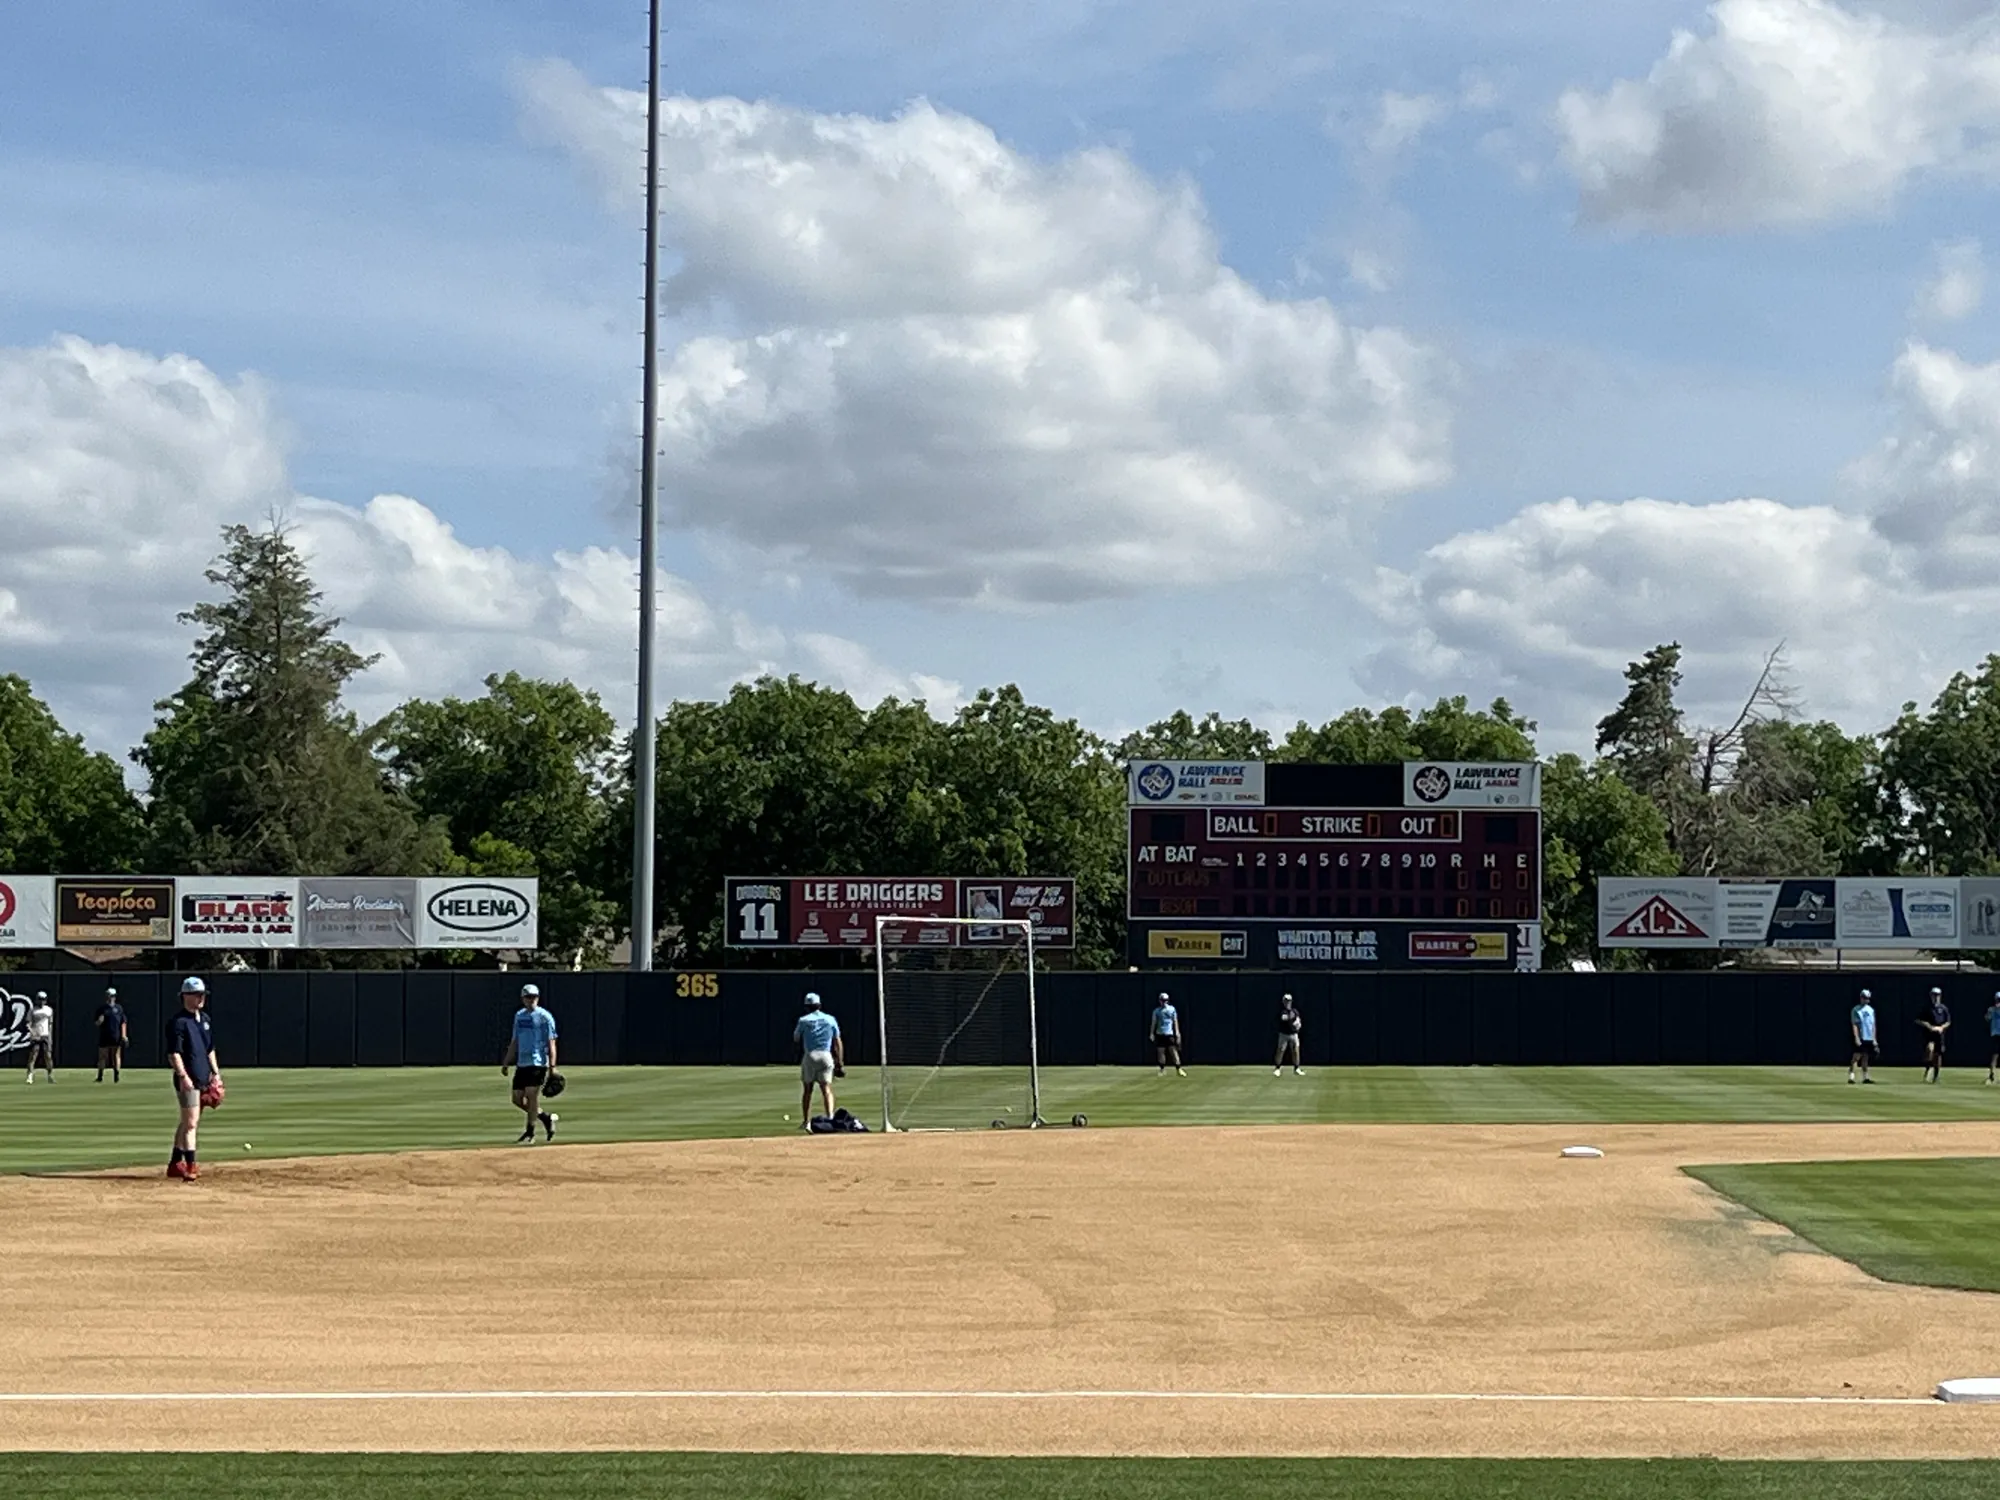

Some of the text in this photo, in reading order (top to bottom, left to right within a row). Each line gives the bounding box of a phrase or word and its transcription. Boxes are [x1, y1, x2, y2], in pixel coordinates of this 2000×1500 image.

[1180, 766, 1246, 777] LAWRENCE
[1456, 768, 1522, 778] LAWRENCE
[1454, 779, 1482, 790] HALL
[1214, 816, 1259, 833] BALL
[1302, 817, 1363, 834] STRIKE
[1400, 817, 1436, 834] OUT
[1138, 845, 1197, 862] AT BAT
[1236, 853, 1244, 867] 1
[1256, 853, 1266, 867] 2
[1277, 853, 1287, 867] 3
[1297, 853, 1307, 867] 4
[1319, 853, 1329, 867] 5
[1338, 853, 1349, 867] 6
[1361, 853, 1371, 867] 7
[1380, 853, 1391, 867] 8
[1401, 853, 1412, 867] 9
[1419, 853, 1436, 867] 10
[1450, 853, 1462, 867] R
[1483, 853, 1496, 867] H
[1516, 853, 1527, 867] E
[804, 883, 943, 901] LEE DRIGGERS
[75, 892, 156, 913] Teapioca
[198, 902, 289, 917] BLACK
[438, 900, 518, 916] HELENA
[740, 903, 778, 940] 11
[848, 913, 859, 926] 4
[1626, 901, 1688, 934] ACI
[184, 924, 293, 934] HEATING & AIR
[1222, 938, 1243, 950] CAT
[1278, 930, 1331, 944] WHATEVER
[1334, 931, 1353, 944] THE
[1278, 946, 1331, 959] WHATEVER
[1333, 946, 1343, 959] IT
[1415, 941, 1459, 950] WARREN
[676, 973, 719, 997] 365
